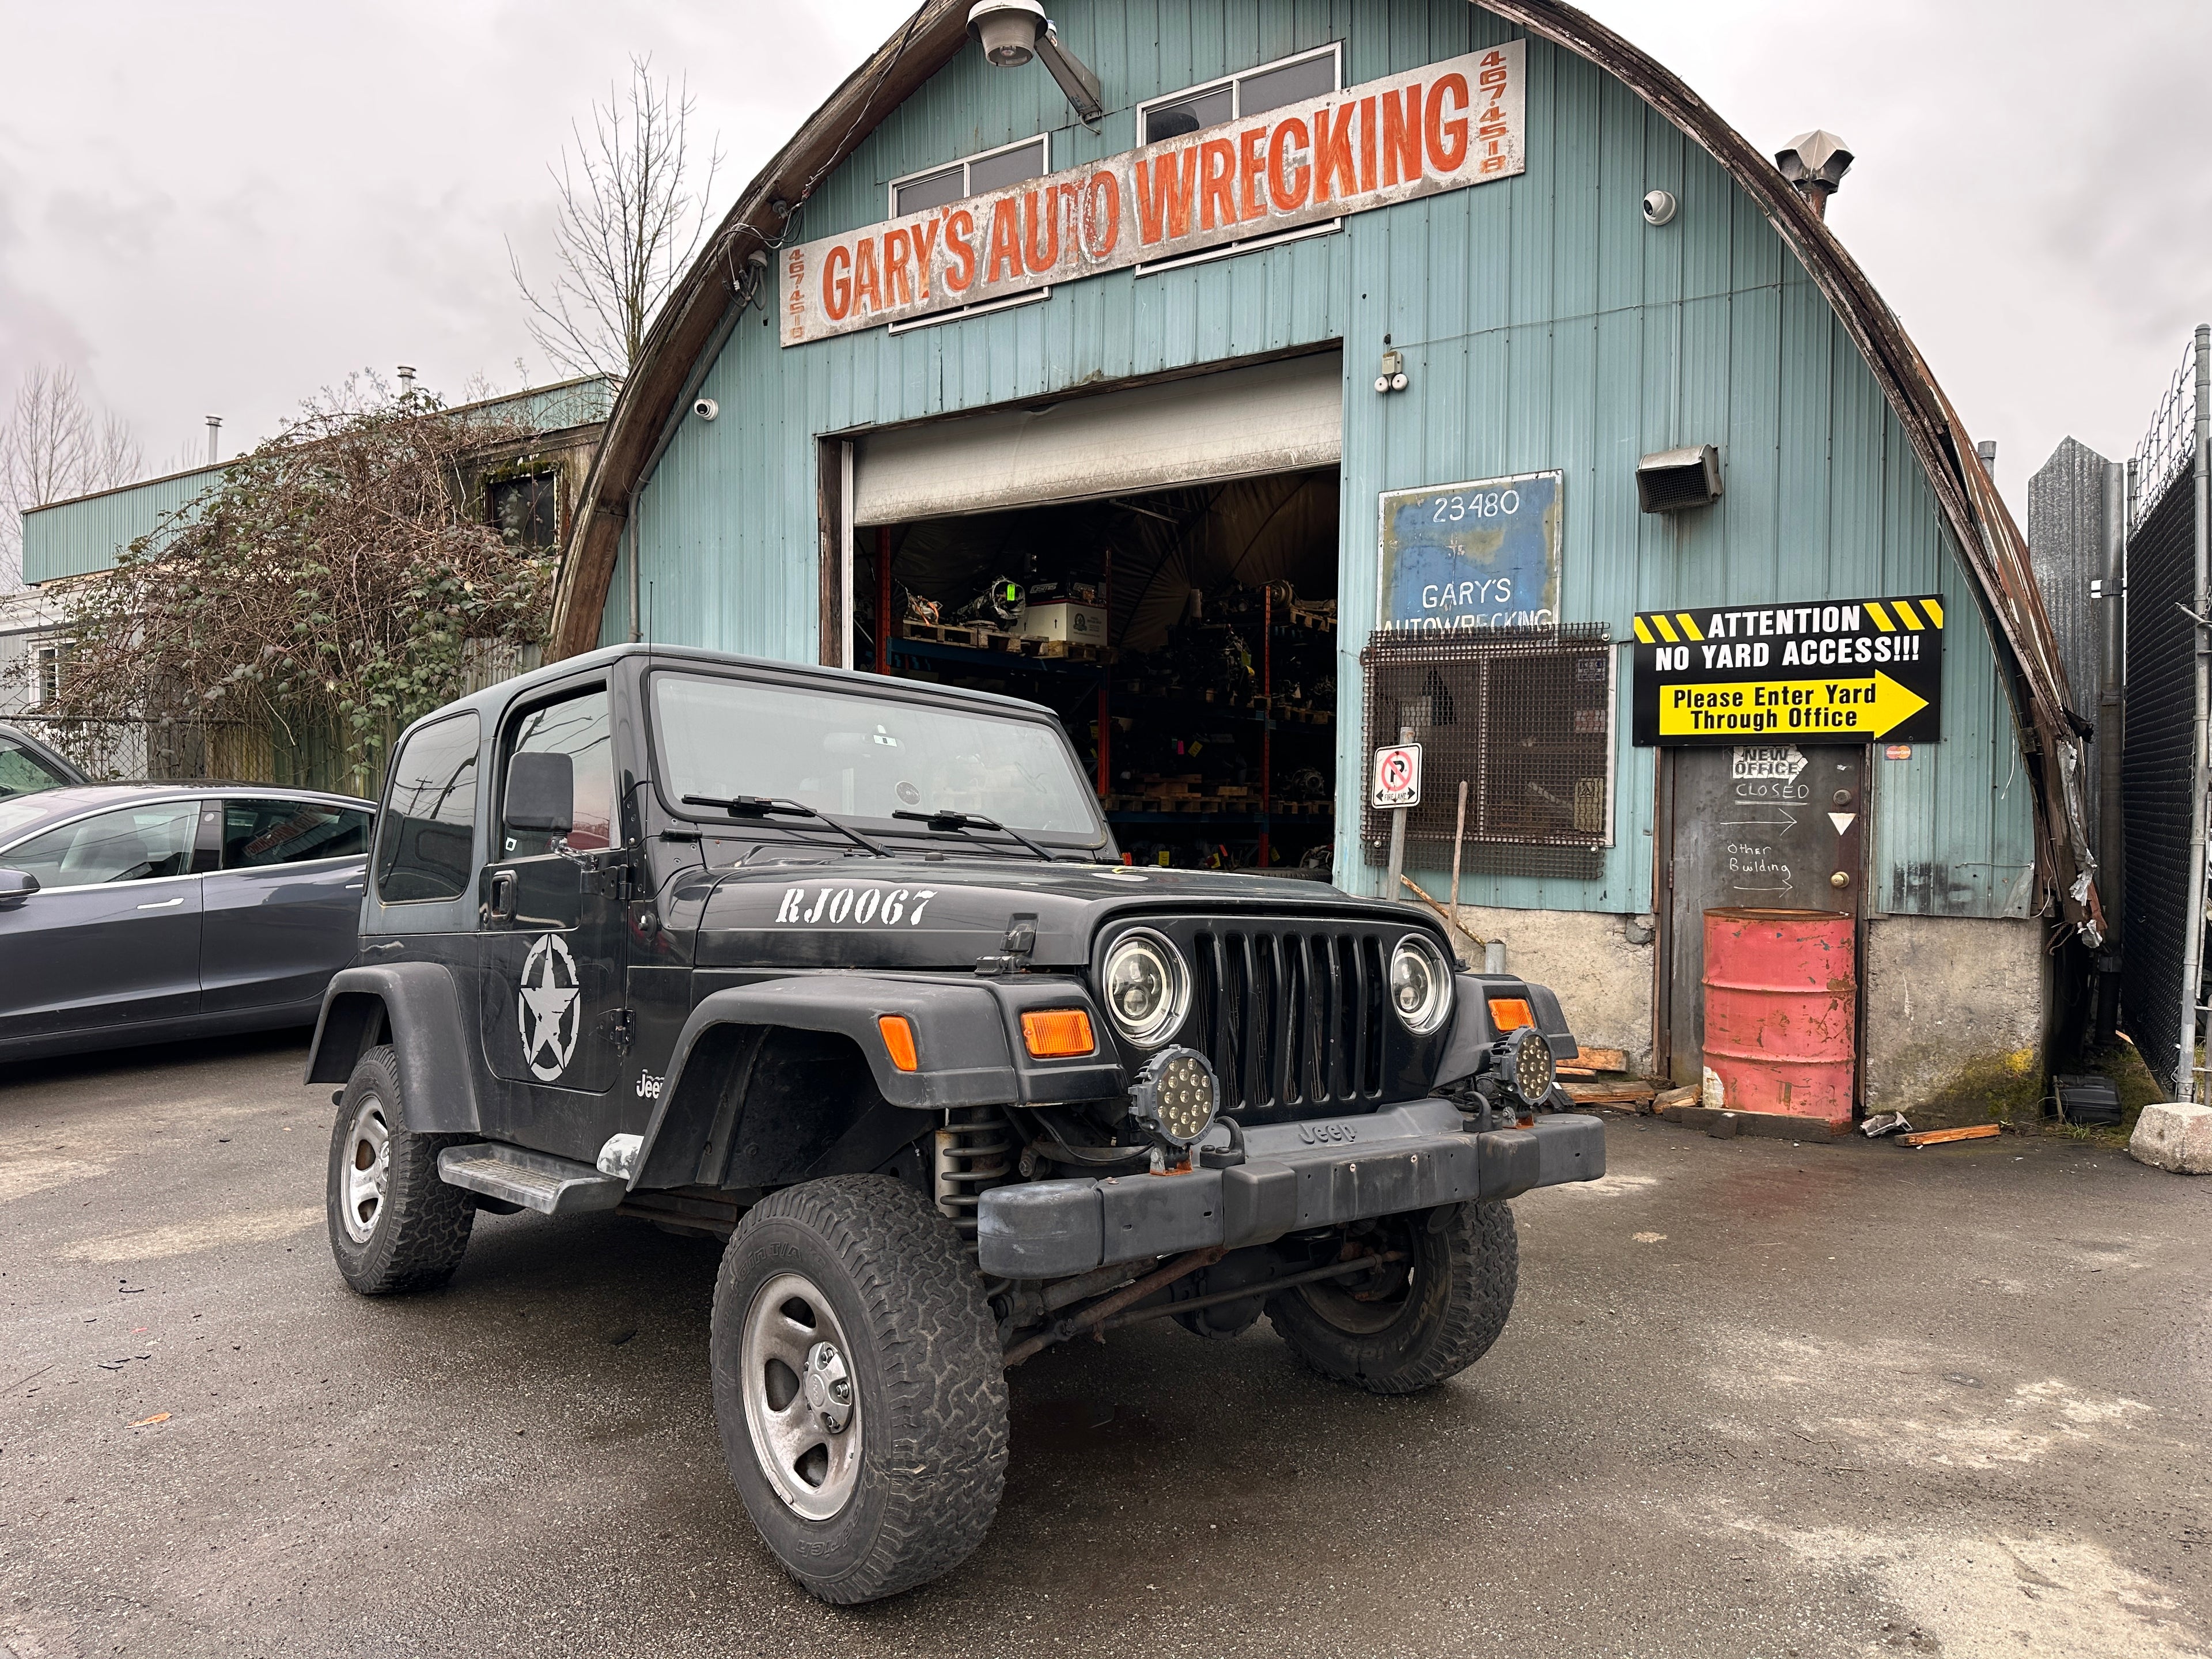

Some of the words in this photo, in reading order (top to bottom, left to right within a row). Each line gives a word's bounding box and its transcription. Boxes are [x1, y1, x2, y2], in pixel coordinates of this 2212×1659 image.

[821, 207, 975, 321] GARY'S
[988, 171, 1119, 283] AUTO
[1136, 73, 1469, 246] WRECKING
[1433, 490, 1520, 522] 23480
[1422, 578, 1511, 608] GARY'S
[1708, 605, 1861, 638] ATTENTION
[1656, 646, 1689, 671] NO
[1701, 642, 1770, 669] YARD
[1782, 635, 1919, 665] ACCESS!!!
[1674, 689, 1744, 709] Please
[1755, 686, 1815, 706] Enter
[1825, 683, 1876, 704] Yard
[1691, 709, 1777, 732] Through
[1789, 707, 1857, 727] Office
[1735, 761, 1798, 775] OFFICE
[1744, 749, 1787, 760] NEW
[1736, 783, 1809, 798] CLOSED
[1730, 858, 1791, 881] Building
[775, 888, 938, 925] RJ0067
[636, 1069, 664, 1099] Jee
[1299, 1123, 1356, 1145] Jeep
